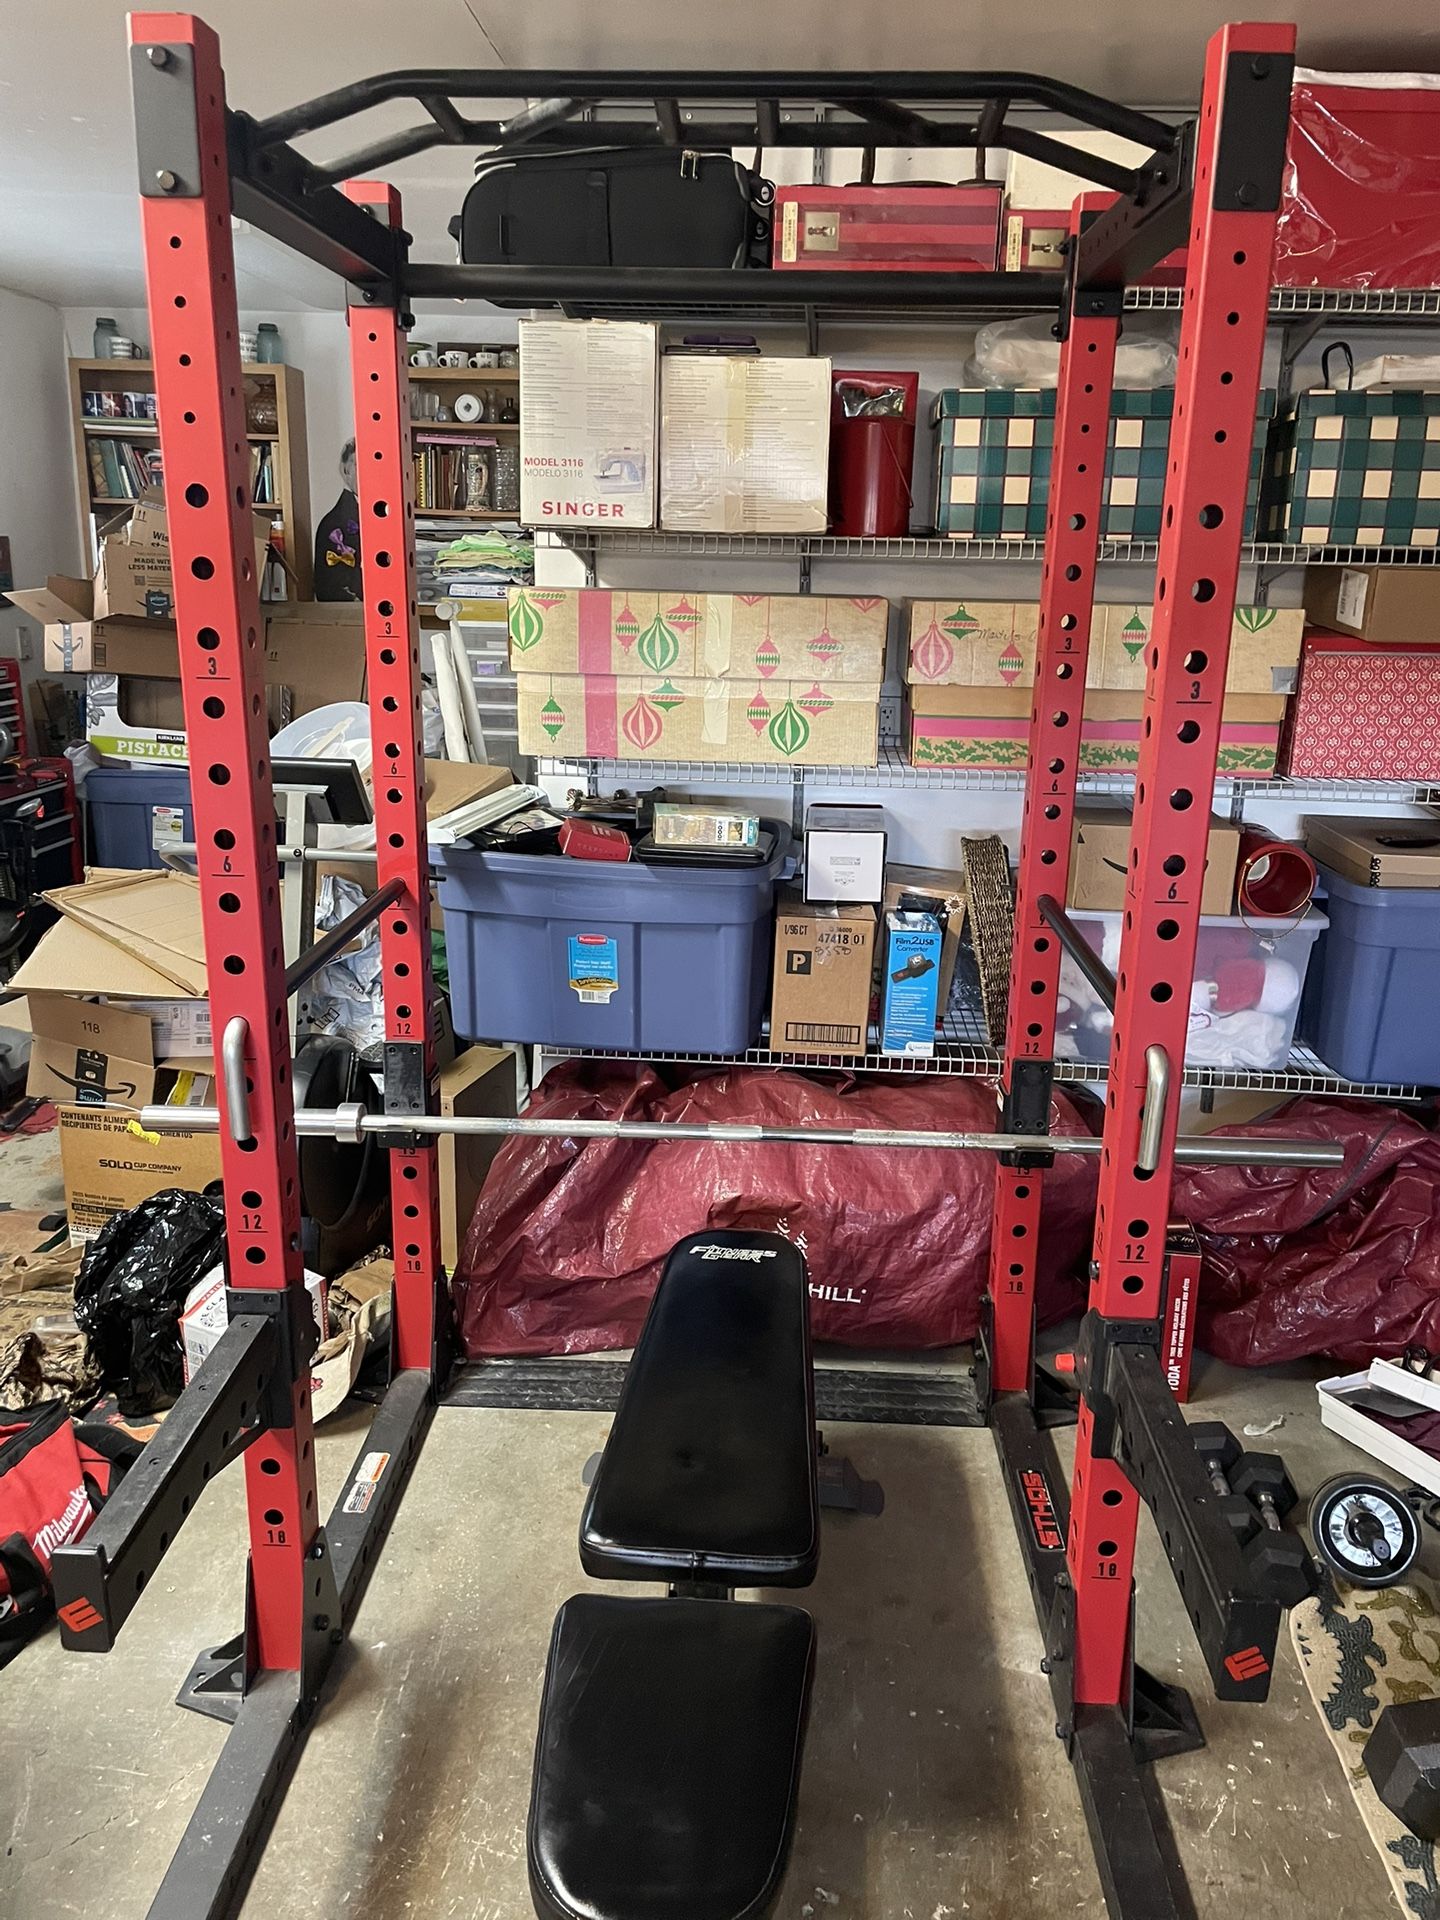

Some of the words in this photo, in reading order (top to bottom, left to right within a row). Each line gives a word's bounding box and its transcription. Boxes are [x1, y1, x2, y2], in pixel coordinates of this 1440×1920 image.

[524, 457, 559, 467] MODEL
[561, 457, 584, 468] 3116
[524, 468, 561, 477] MODELO
[562, 468, 584, 478] 3116
[542, 501, 624, 517] SINGER
[385, 622, 391, 634] 3
[1065, 637, 1072, 650] 3
[208, 657, 217, 675] 3
[1190, 681, 1201, 700] 3
[391, 762, 398, 775] 6
[1051, 780, 1058, 792] 6
[223, 855, 231, 872] 6
[1168, 882, 1177, 899] 6
[799, 926, 808, 935] CT
[818, 933, 849, 944] 47418
[853, 934, 865, 944] 01
[897, 945, 929, 953] Converter
[792, 953, 806, 972] P
[81, 1021, 101, 1034] 118
[397, 1023, 411, 1034] 12
[1025, 1042, 1039, 1053] 12
[61, 1112, 102, 1123] CONTENANTS
[61, 1120, 102, 1131] RECIPIENTES
[103, 1123, 112, 1132] DE
[99, 1159, 132, 1169] SOLO
[148, 1163, 182, 1172] COMPANY
[242, 1215, 262, 1229] 12
[1125, 1244, 1145, 1260] 12
[407, 1260, 421, 1271] 18
[1009, 1281, 1023, 1291] 18
[1182, 1278, 1190, 1291] FÊTES
[808, 1283, 861, 1304] HILL
[1172, 1312, 1180, 1330] HOLIDAY
[1170, 1330, 1178, 1346] TOPPER
[1021, 1473, 1060, 1545] ETHOS
[267, 1530, 286, 1543] 18
[1098, 1562, 1117, 1577] 18
